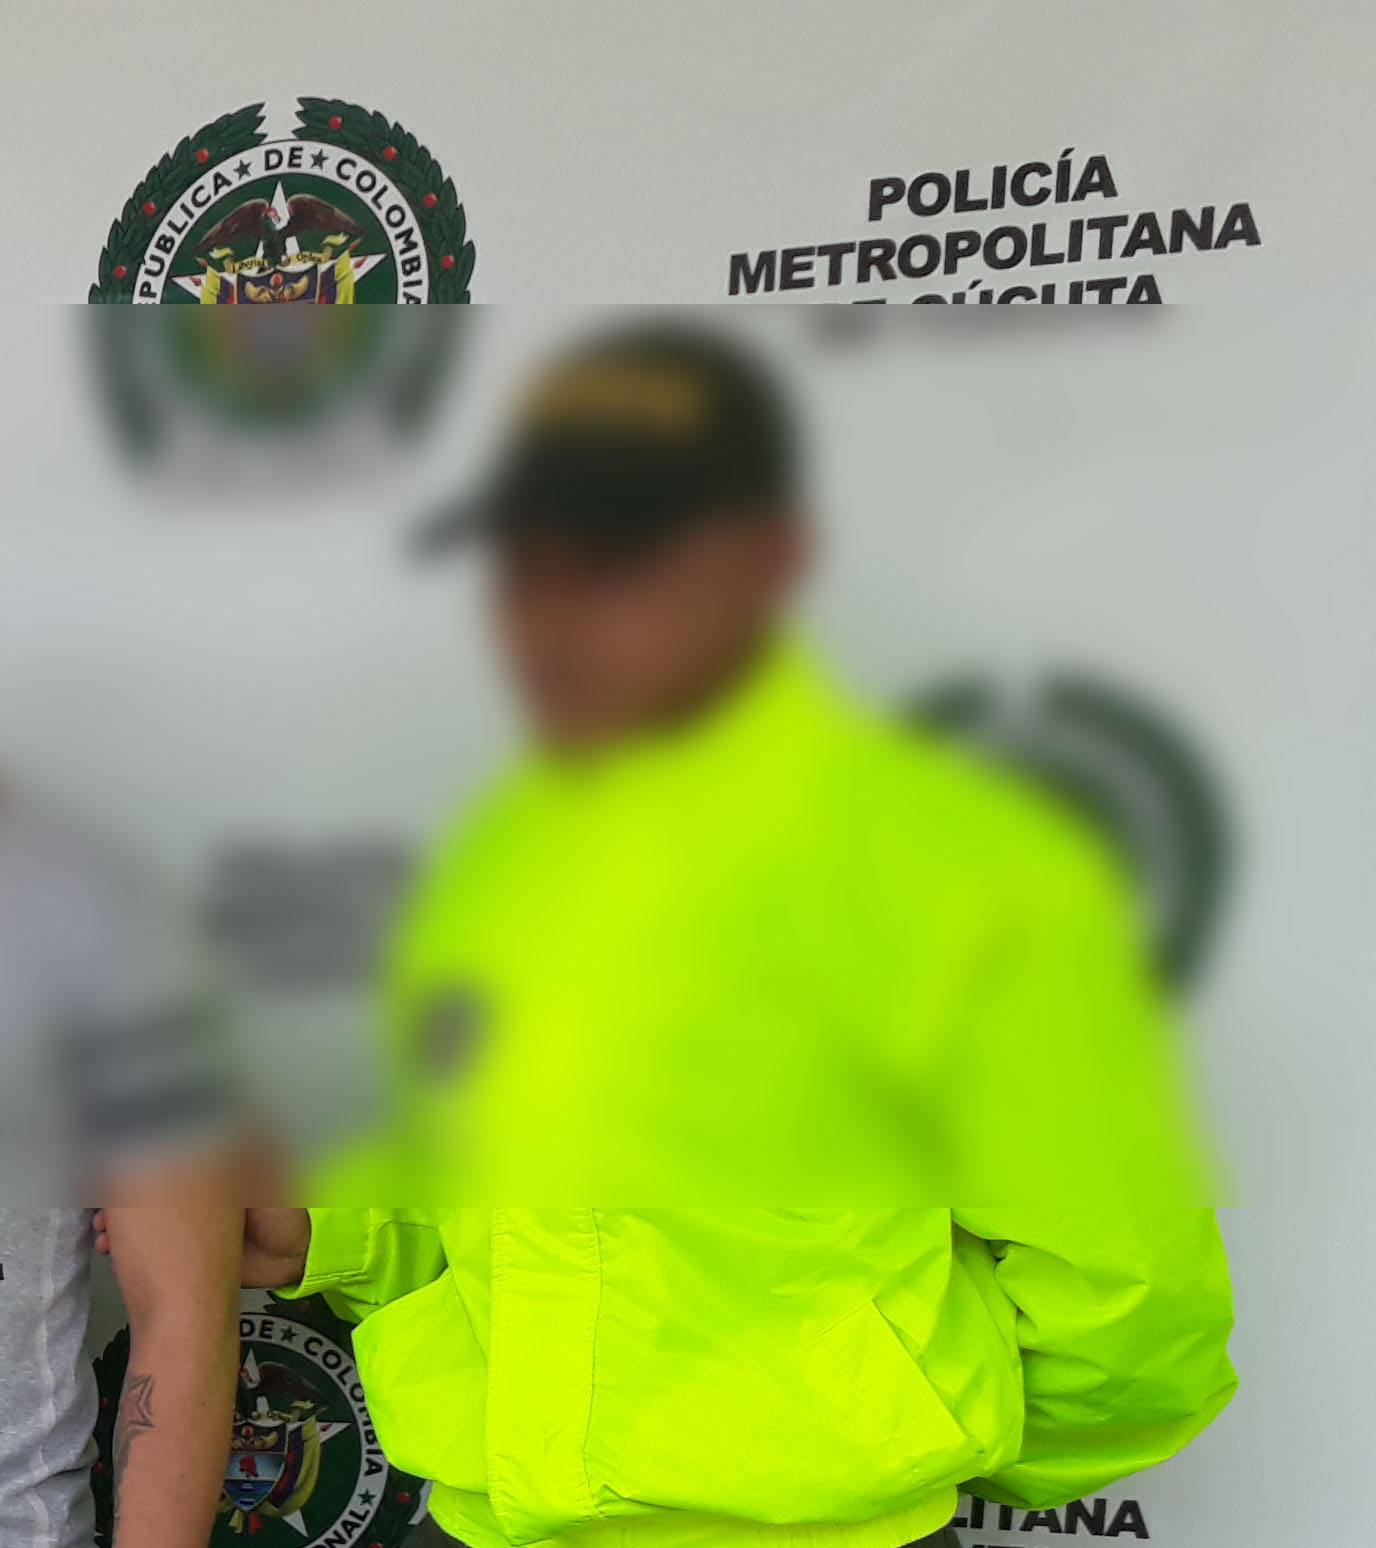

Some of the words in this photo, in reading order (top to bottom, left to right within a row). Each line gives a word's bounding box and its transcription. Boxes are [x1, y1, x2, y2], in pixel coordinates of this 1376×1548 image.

[139, 171, 233, 304] PÚBLICA
[264, 147, 304, 171] DE
[867, 148, 1119, 221] POLICÍA
[727, 202, 1262, 296] METROPOLITANA
[239, 1319, 274, 1340] DE
